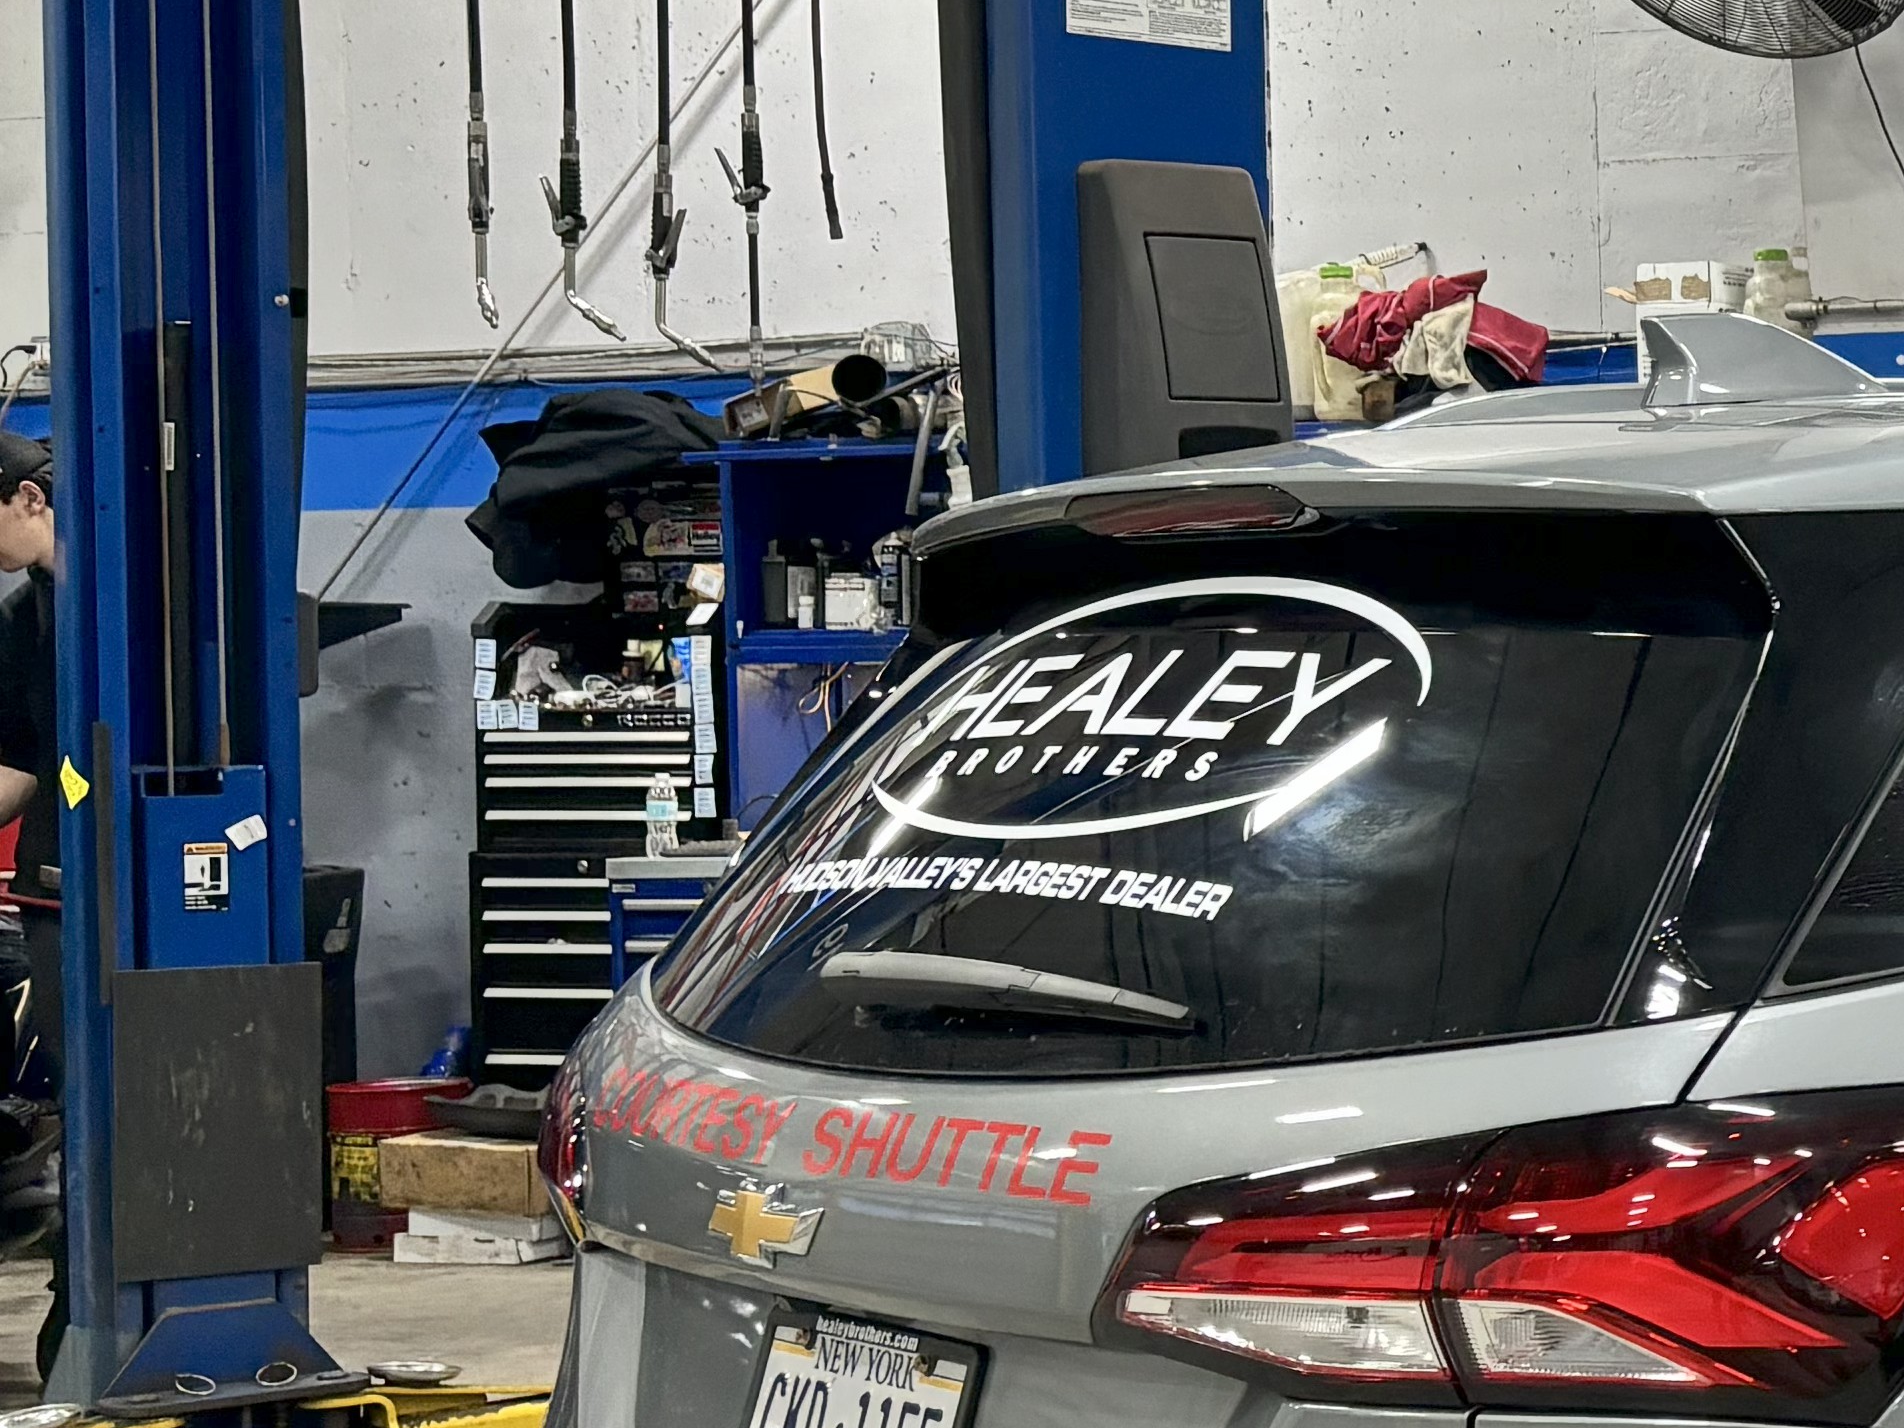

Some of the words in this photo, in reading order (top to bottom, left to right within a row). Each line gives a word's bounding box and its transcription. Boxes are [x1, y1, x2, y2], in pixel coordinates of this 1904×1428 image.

[915, 649, 1392, 746] HEALEY
[930, 747, 1219, 782] BROTHERS
[781, 857, 878, 896] HUDSON
[872, 856, 985, 891] VALLEY'S
[978, 859, 1109, 902] LARGEST
[1100, 870, 1233, 923] DEALER
[592, 1066, 797, 1167] COURTESY
[803, 1107, 1112, 1207] SHUTTLE
[814, 1336, 860, 1378] NEW
[865, 1347, 918, 1392] YORK
[816, 1315, 919, 1352] healeybrothers.com
